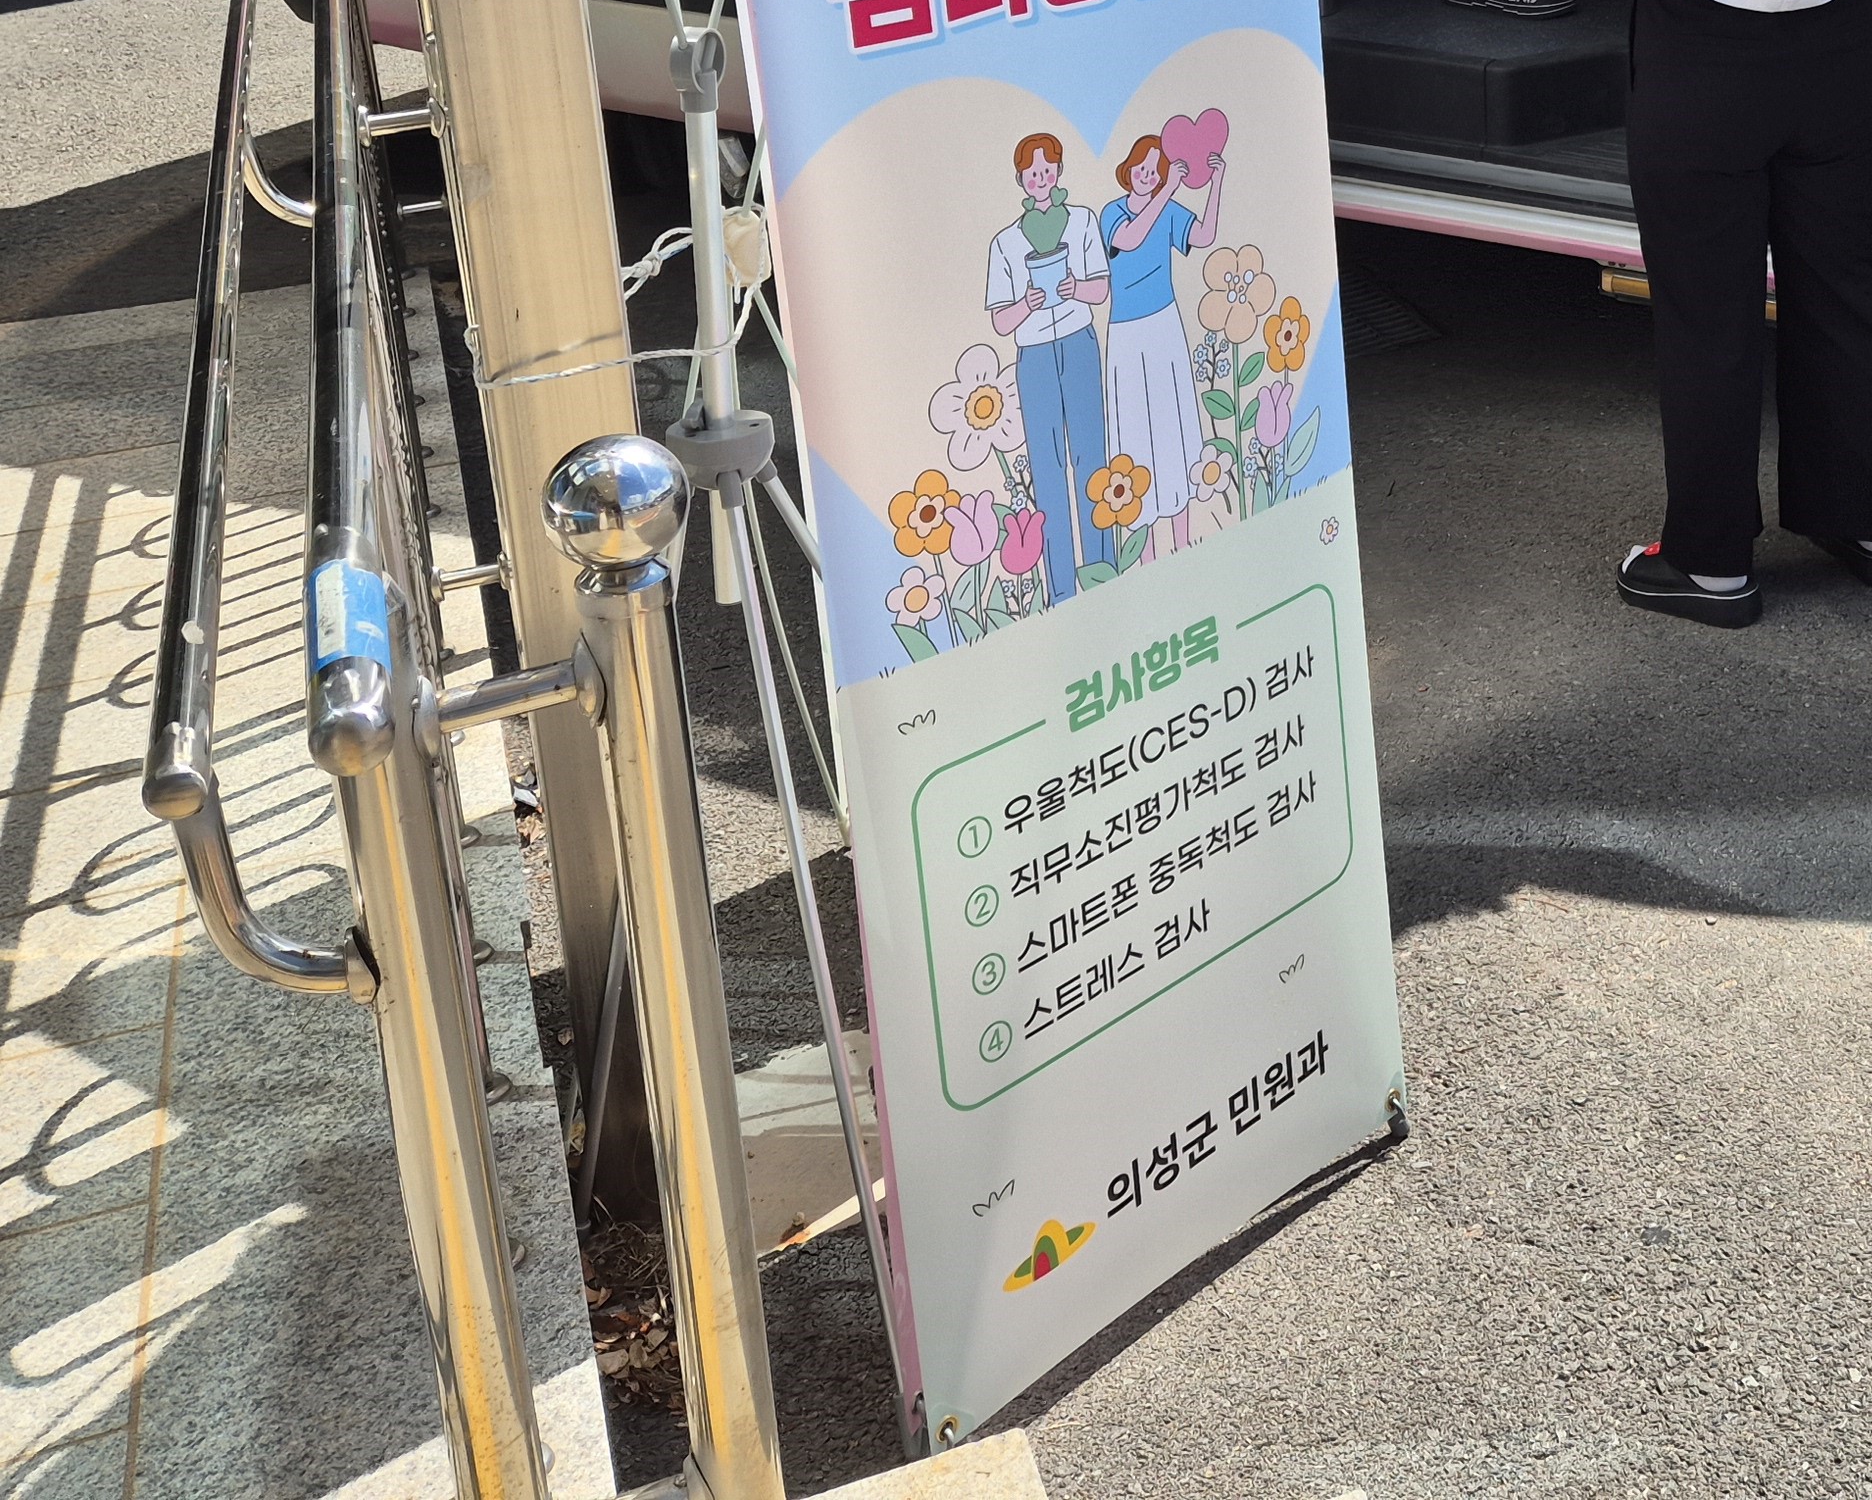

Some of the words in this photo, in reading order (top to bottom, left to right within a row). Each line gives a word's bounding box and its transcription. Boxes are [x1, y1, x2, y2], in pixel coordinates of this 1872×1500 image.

[1003, 677, 1257, 835] 우울척도(CES-D)
[1264, 645, 1316, 697] 검사
[1065, 615, 1220, 733] 검사항목
[1010, 747, 1245, 900] 직무소진평가척도
[1253, 714, 1307, 769] 검사
[1017, 873, 1140, 974] 스마트폰
[1147, 803, 1260, 896] 중독척도
[1266, 769, 1318, 826] 검사
[1024, 941, 1146, 1041] 스트레스
[1153, 897, 1212, 961] 검사
[1105, 1109, 1219, 1220] 의성군
[1227, 1028, 1330, 1137] 민원과
